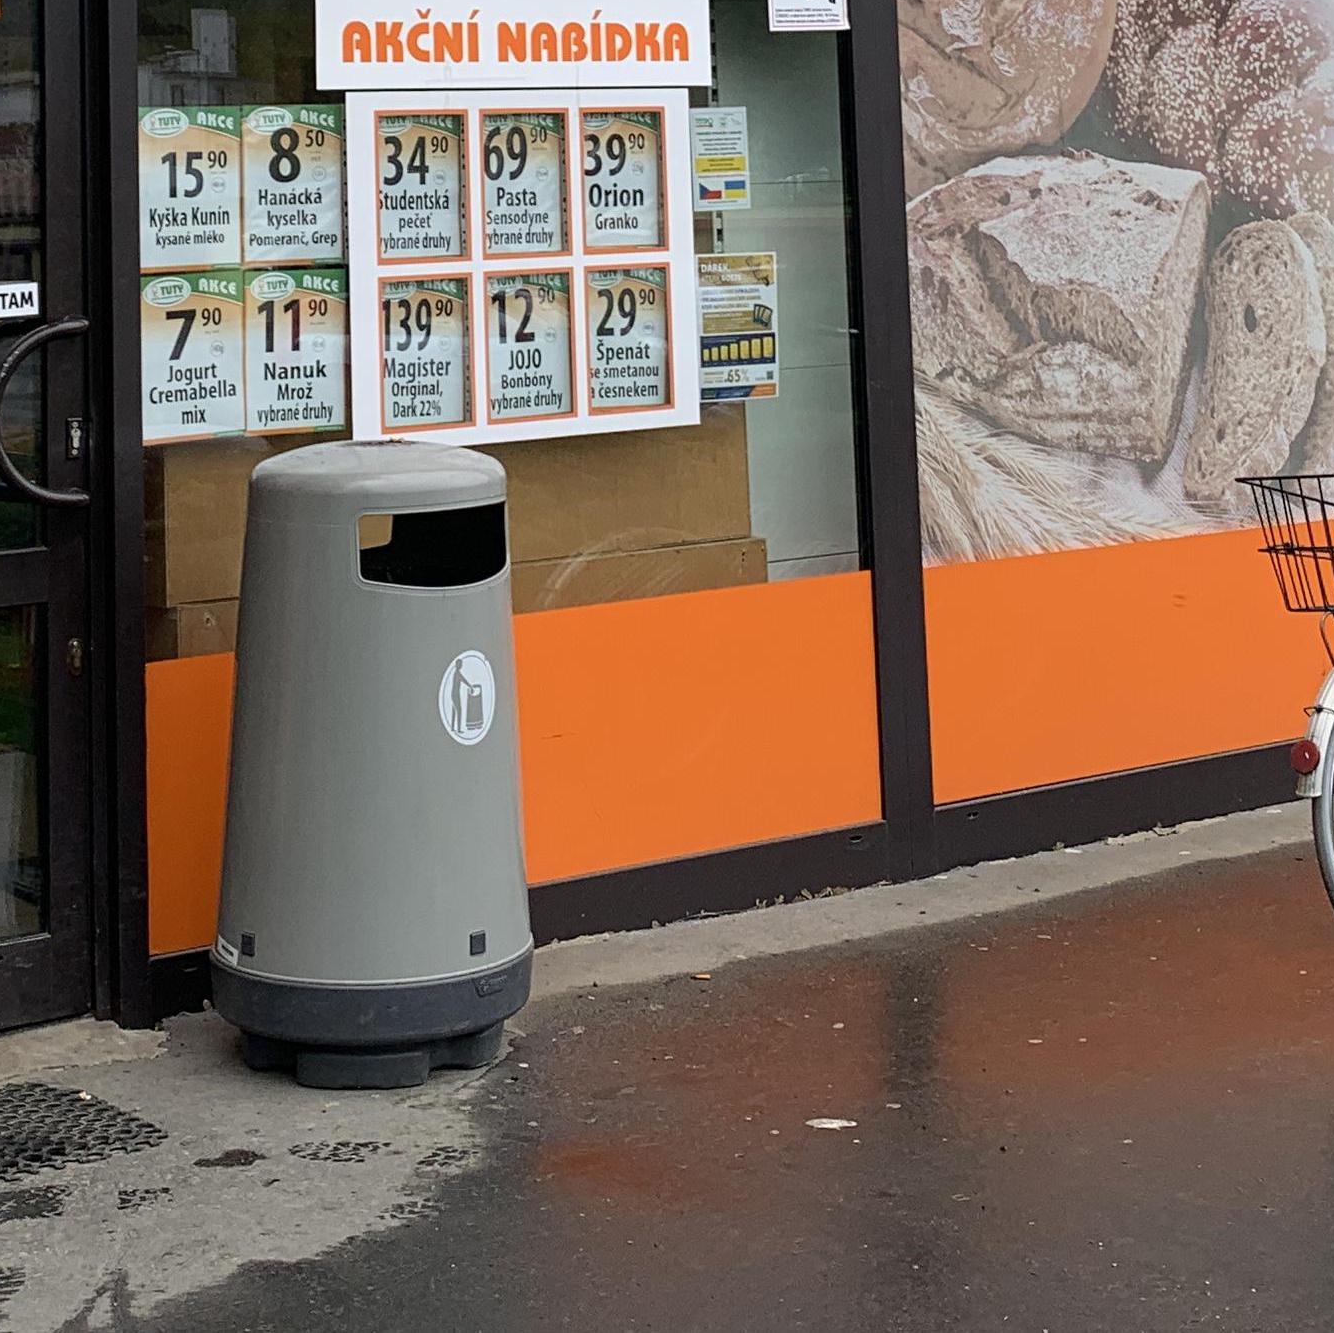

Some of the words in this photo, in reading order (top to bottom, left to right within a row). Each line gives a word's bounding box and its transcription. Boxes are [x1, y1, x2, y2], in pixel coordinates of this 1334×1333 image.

[341, 8, 481, 63] AKČNÍ
[496, 9, 689, 63] NABÍDKA
[157, 116, 181, 126] TUTY
[197, 112, 235, 130] AKCE
[262, 114, 286, 124] TUTY
[299, 109, 335, 128] AKCE
[269, 127, 301, 183] 8
[305, 129, 325, 147] 50
[383, 135, 429, 186] 34
[431, 136, 449, 154] 90
[484, 126, 527, 181] 69
[530, 126, 547, 144] 90
[584, 133, 626, 177] 39
[628, 133, 645, 150] 90
[161, 151, 204, 198] 15
[207, 150, 227, 168] 90
[258, 187, 322, 206] Hanácká
[496, 187, 537, 206] Pasta
[588, 183, 644, 208] Orion
[149, 207, 188, 232] Kyška
[191, 206, 230, 226] Kunín
[267, 210, 317, 230] kyselka
[398, 212, 433, 232] pečeť
[486, 209, 549, 232] Sensodyne
[595, 212, 639, 230] Granko
[156, 231, 191, 249] kysané
[193, 229, 225, 244] mléko
[249, 232, 309, 246] Pomeranč,
[311, 231, 338, 247] Grep
[422, 232, 452, 252] druhy
[486, 228, 523, 249] ybrané
[525, 227, 554, 247] druhy
[160, 284, 184, 296] TUTY
[198, 278, 237, 295] AKCE
[267, 279, 288, 290] TUTY
[303, 274, 339, 293] AKCE
[491, 288, 535, 344] 12
[537, 287, 555, 304] 90
[596, 287, 636, 337] 29
[639, 288, 655, 305] 90
[165, 308, 197, 361] 7
[201, 307, 222, 326] 90
[257, 299, 300, 353] 11
[308, 298, 328, 317] 90
[382, 298, 432, 352] 139
[435, 299, 453, 317] 90
[508, 348, 542, 370] JOJO
[596, 339, 650, 365] Špenát
[167, 363, 217, 386] Jogurt
[264, 360, 327, 381] Nanuk
[383, 357, 451, 383] Magister
[603, 365, 659, 379] smetanou
[149, 379, 237, 404] Cremabella
[277, 382, 313, 401] Mrož
[391, 379, 443, 400] Original,
[501, 372, 553, 390] Bonbóny
[598, 381, 659, 399] česnekem
[393, 399, 417, 418] Dark
[419, 400, 442, 417] 22%
[490, 392, 531, 415] vybrané
[534, 389, 563, 410] druhy
[181, 405, 207, 425] mix
[257, 404, 300, 427] vybrané
[302, 402, 334, 423] druhy
